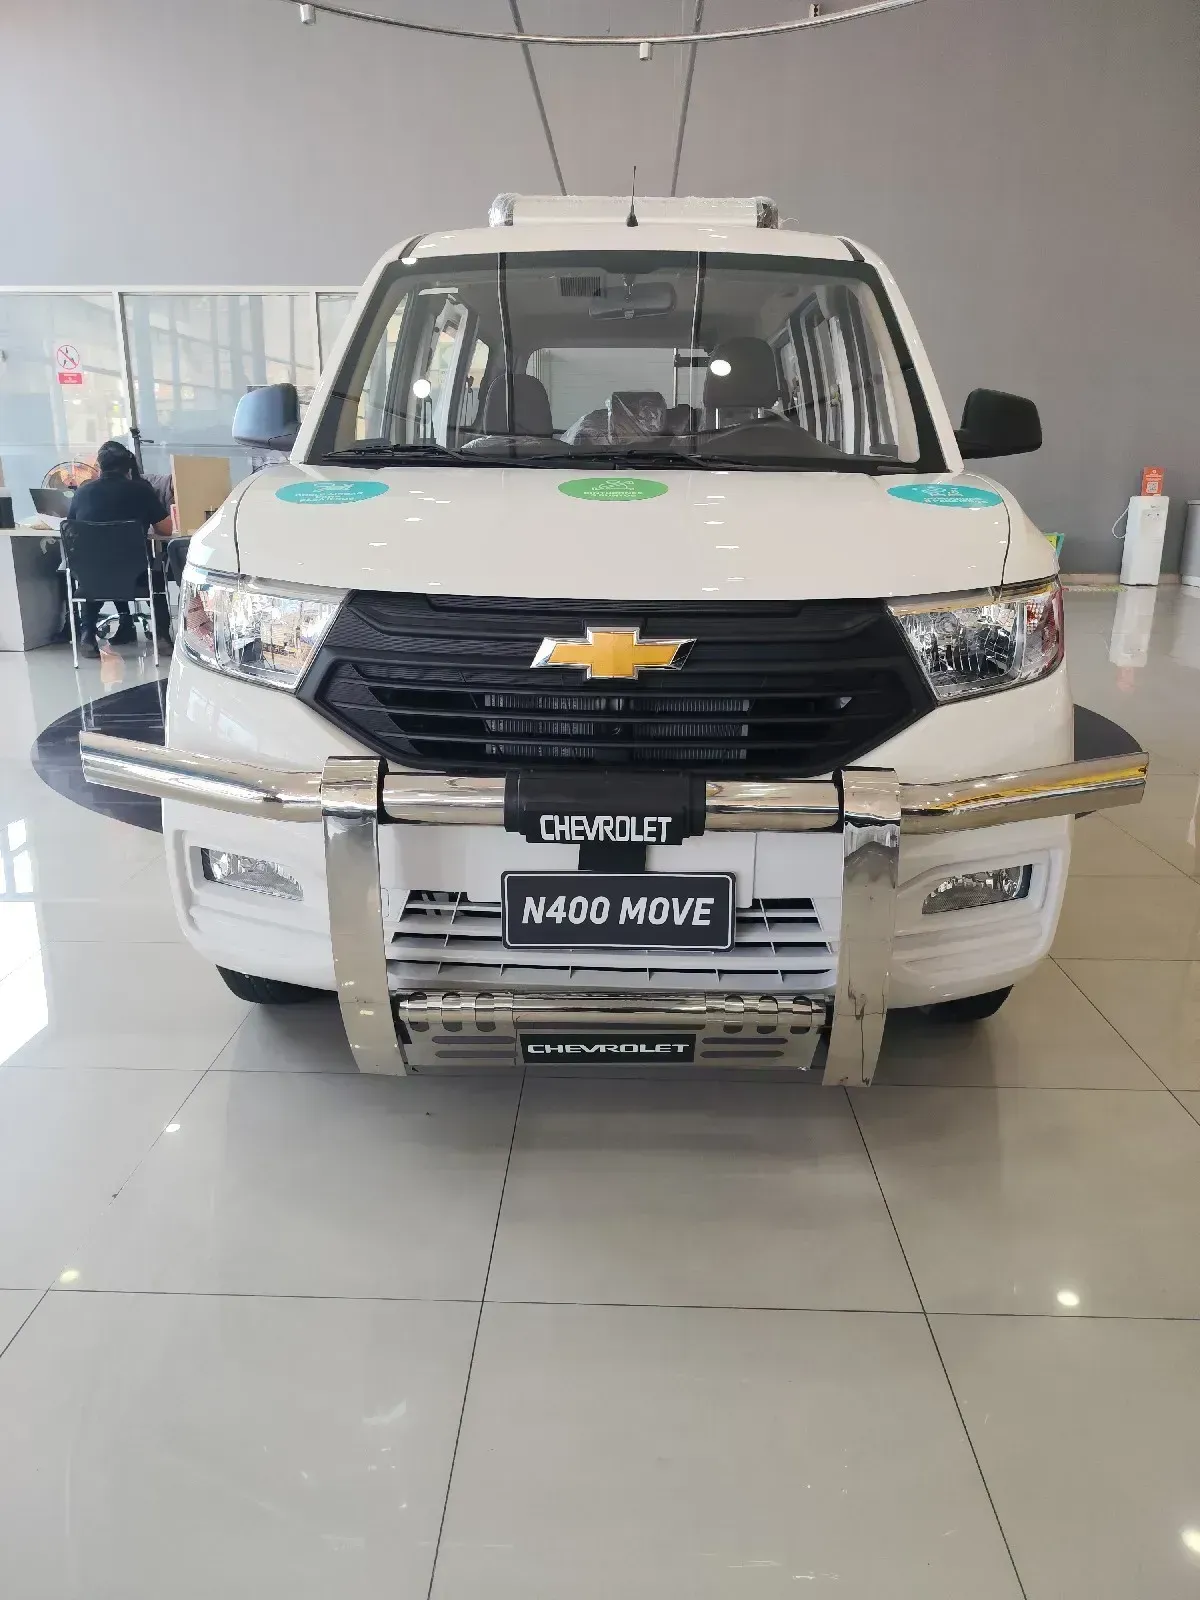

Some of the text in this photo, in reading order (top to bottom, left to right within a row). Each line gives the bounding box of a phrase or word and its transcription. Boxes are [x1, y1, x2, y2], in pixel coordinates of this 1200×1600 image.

[539, 814, 673, 843] CHEVROLET
[521, 895, 715, 926] N400 MOVE
[527, 1044, 690, 1054] CHEVROLET
